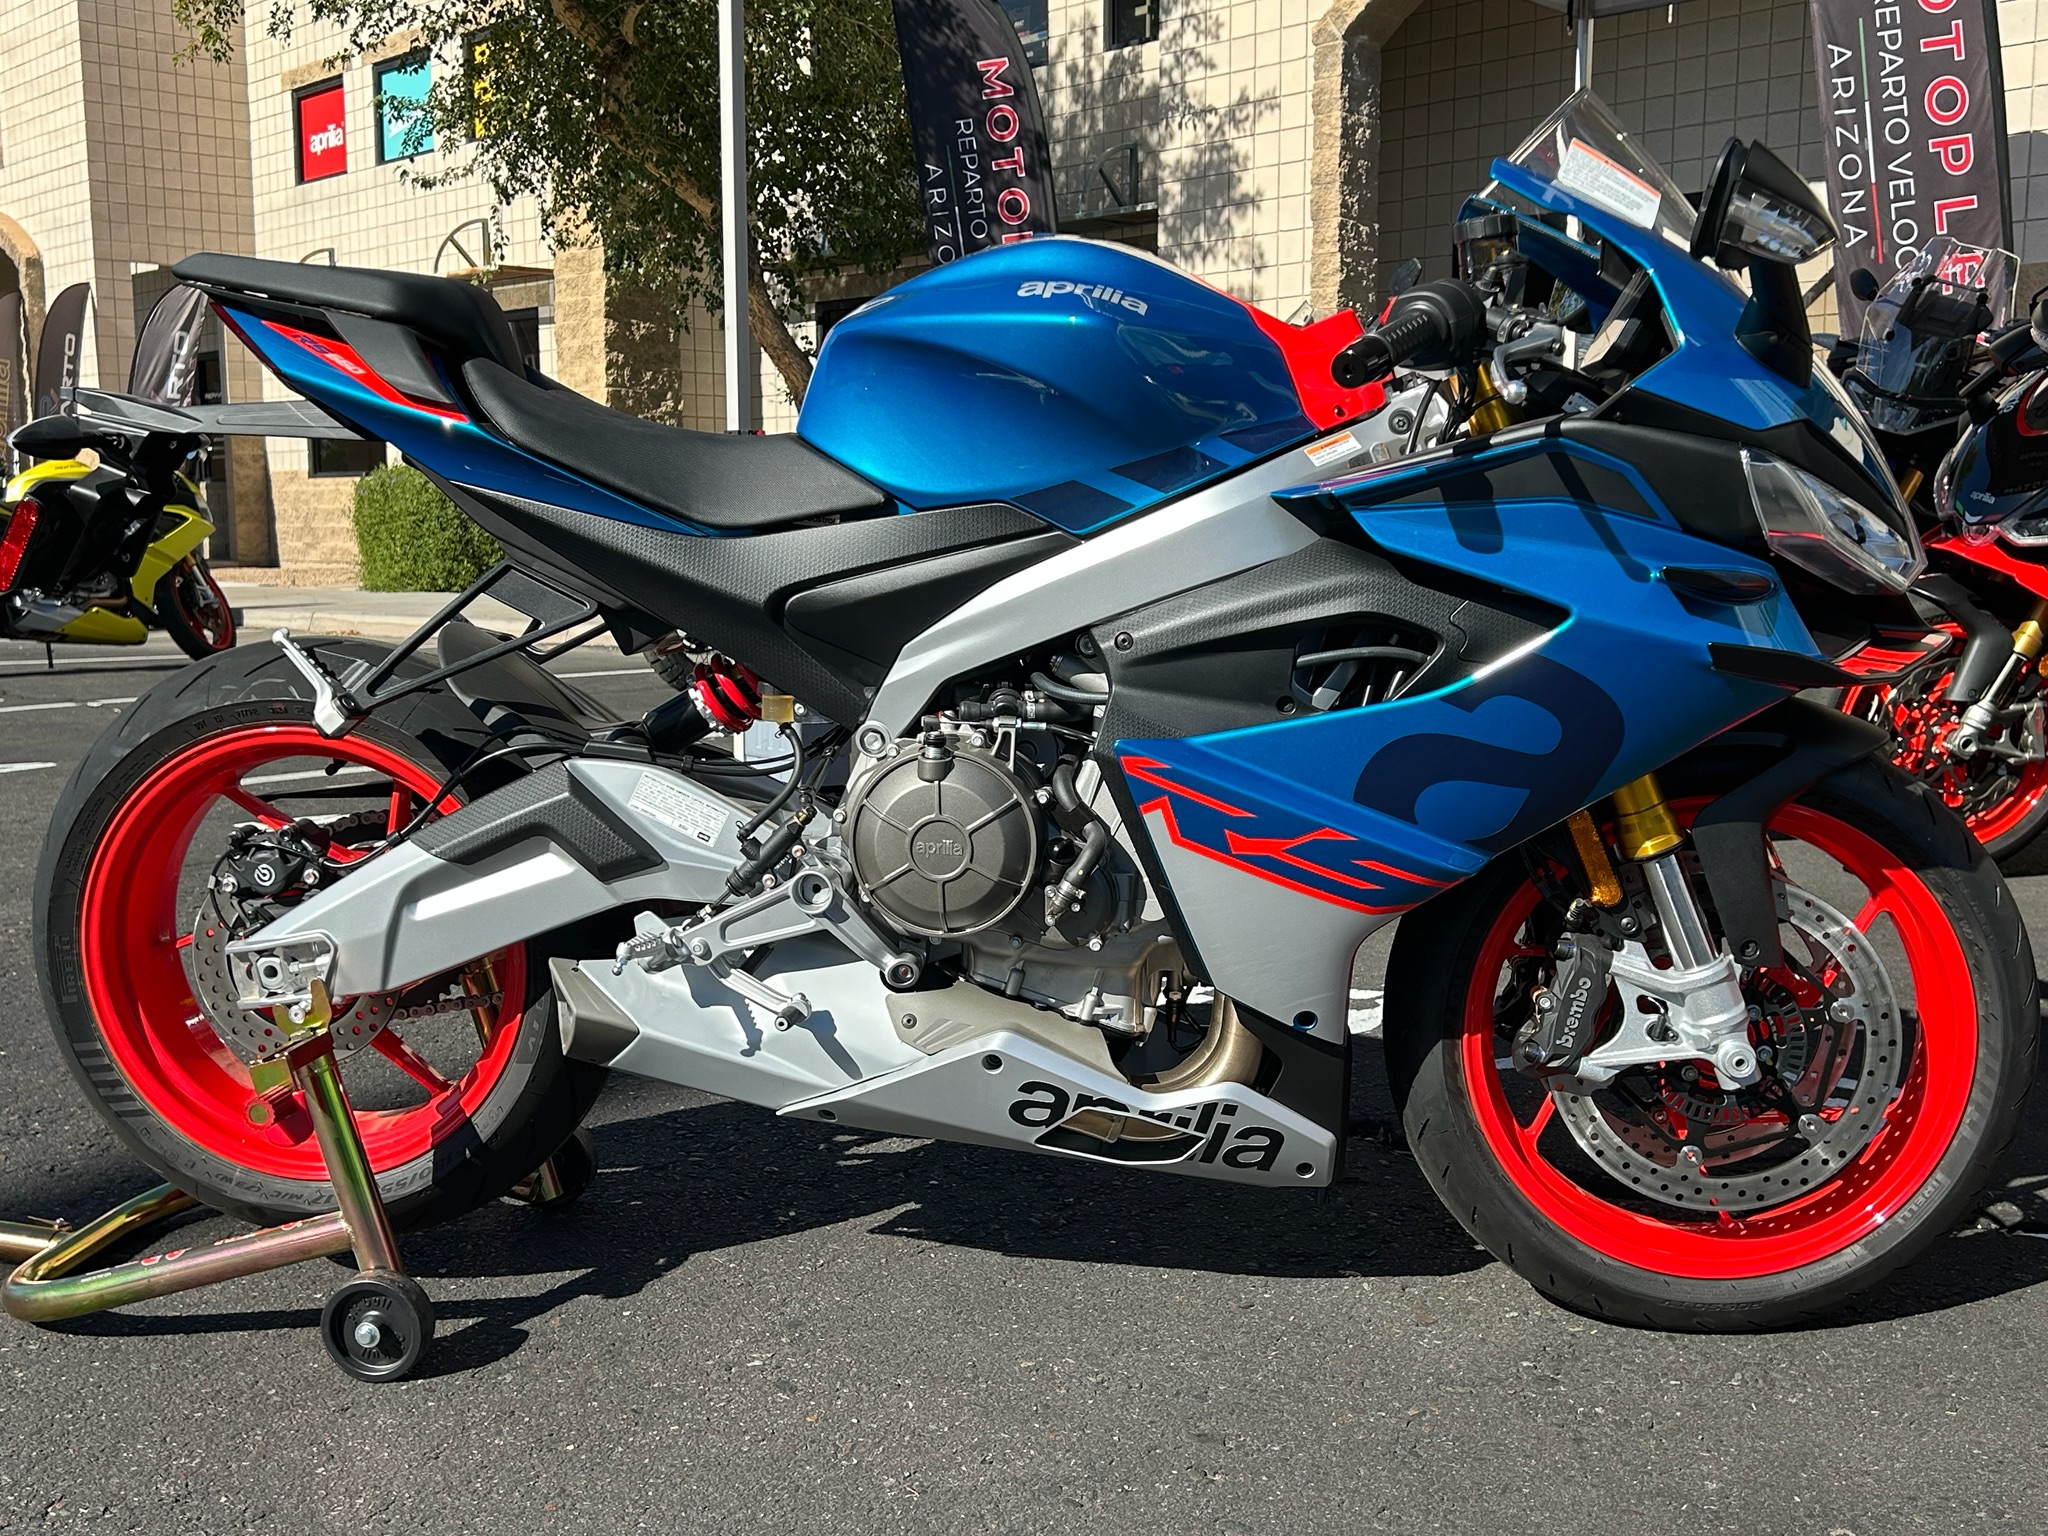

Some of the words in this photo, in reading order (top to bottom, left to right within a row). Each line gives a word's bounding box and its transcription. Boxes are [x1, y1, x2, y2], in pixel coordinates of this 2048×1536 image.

[1873, 0, 1910, 145] EPARTO
[310, 122, 344, 155] aprilia
[1827, 43, 1868, 248] ARIZONA
[955, 118, 988, 239] REPARTO
[1016, 280, 1148, 317] aprilia
[165, 330, 189, 405] RTO
[323, 352, 367, 375] 660
[916, 839, 964, 859] aprilia
[1555, 976, 1592, 1049] brembo
[1008, 1079, 1286, 1172] ailia
